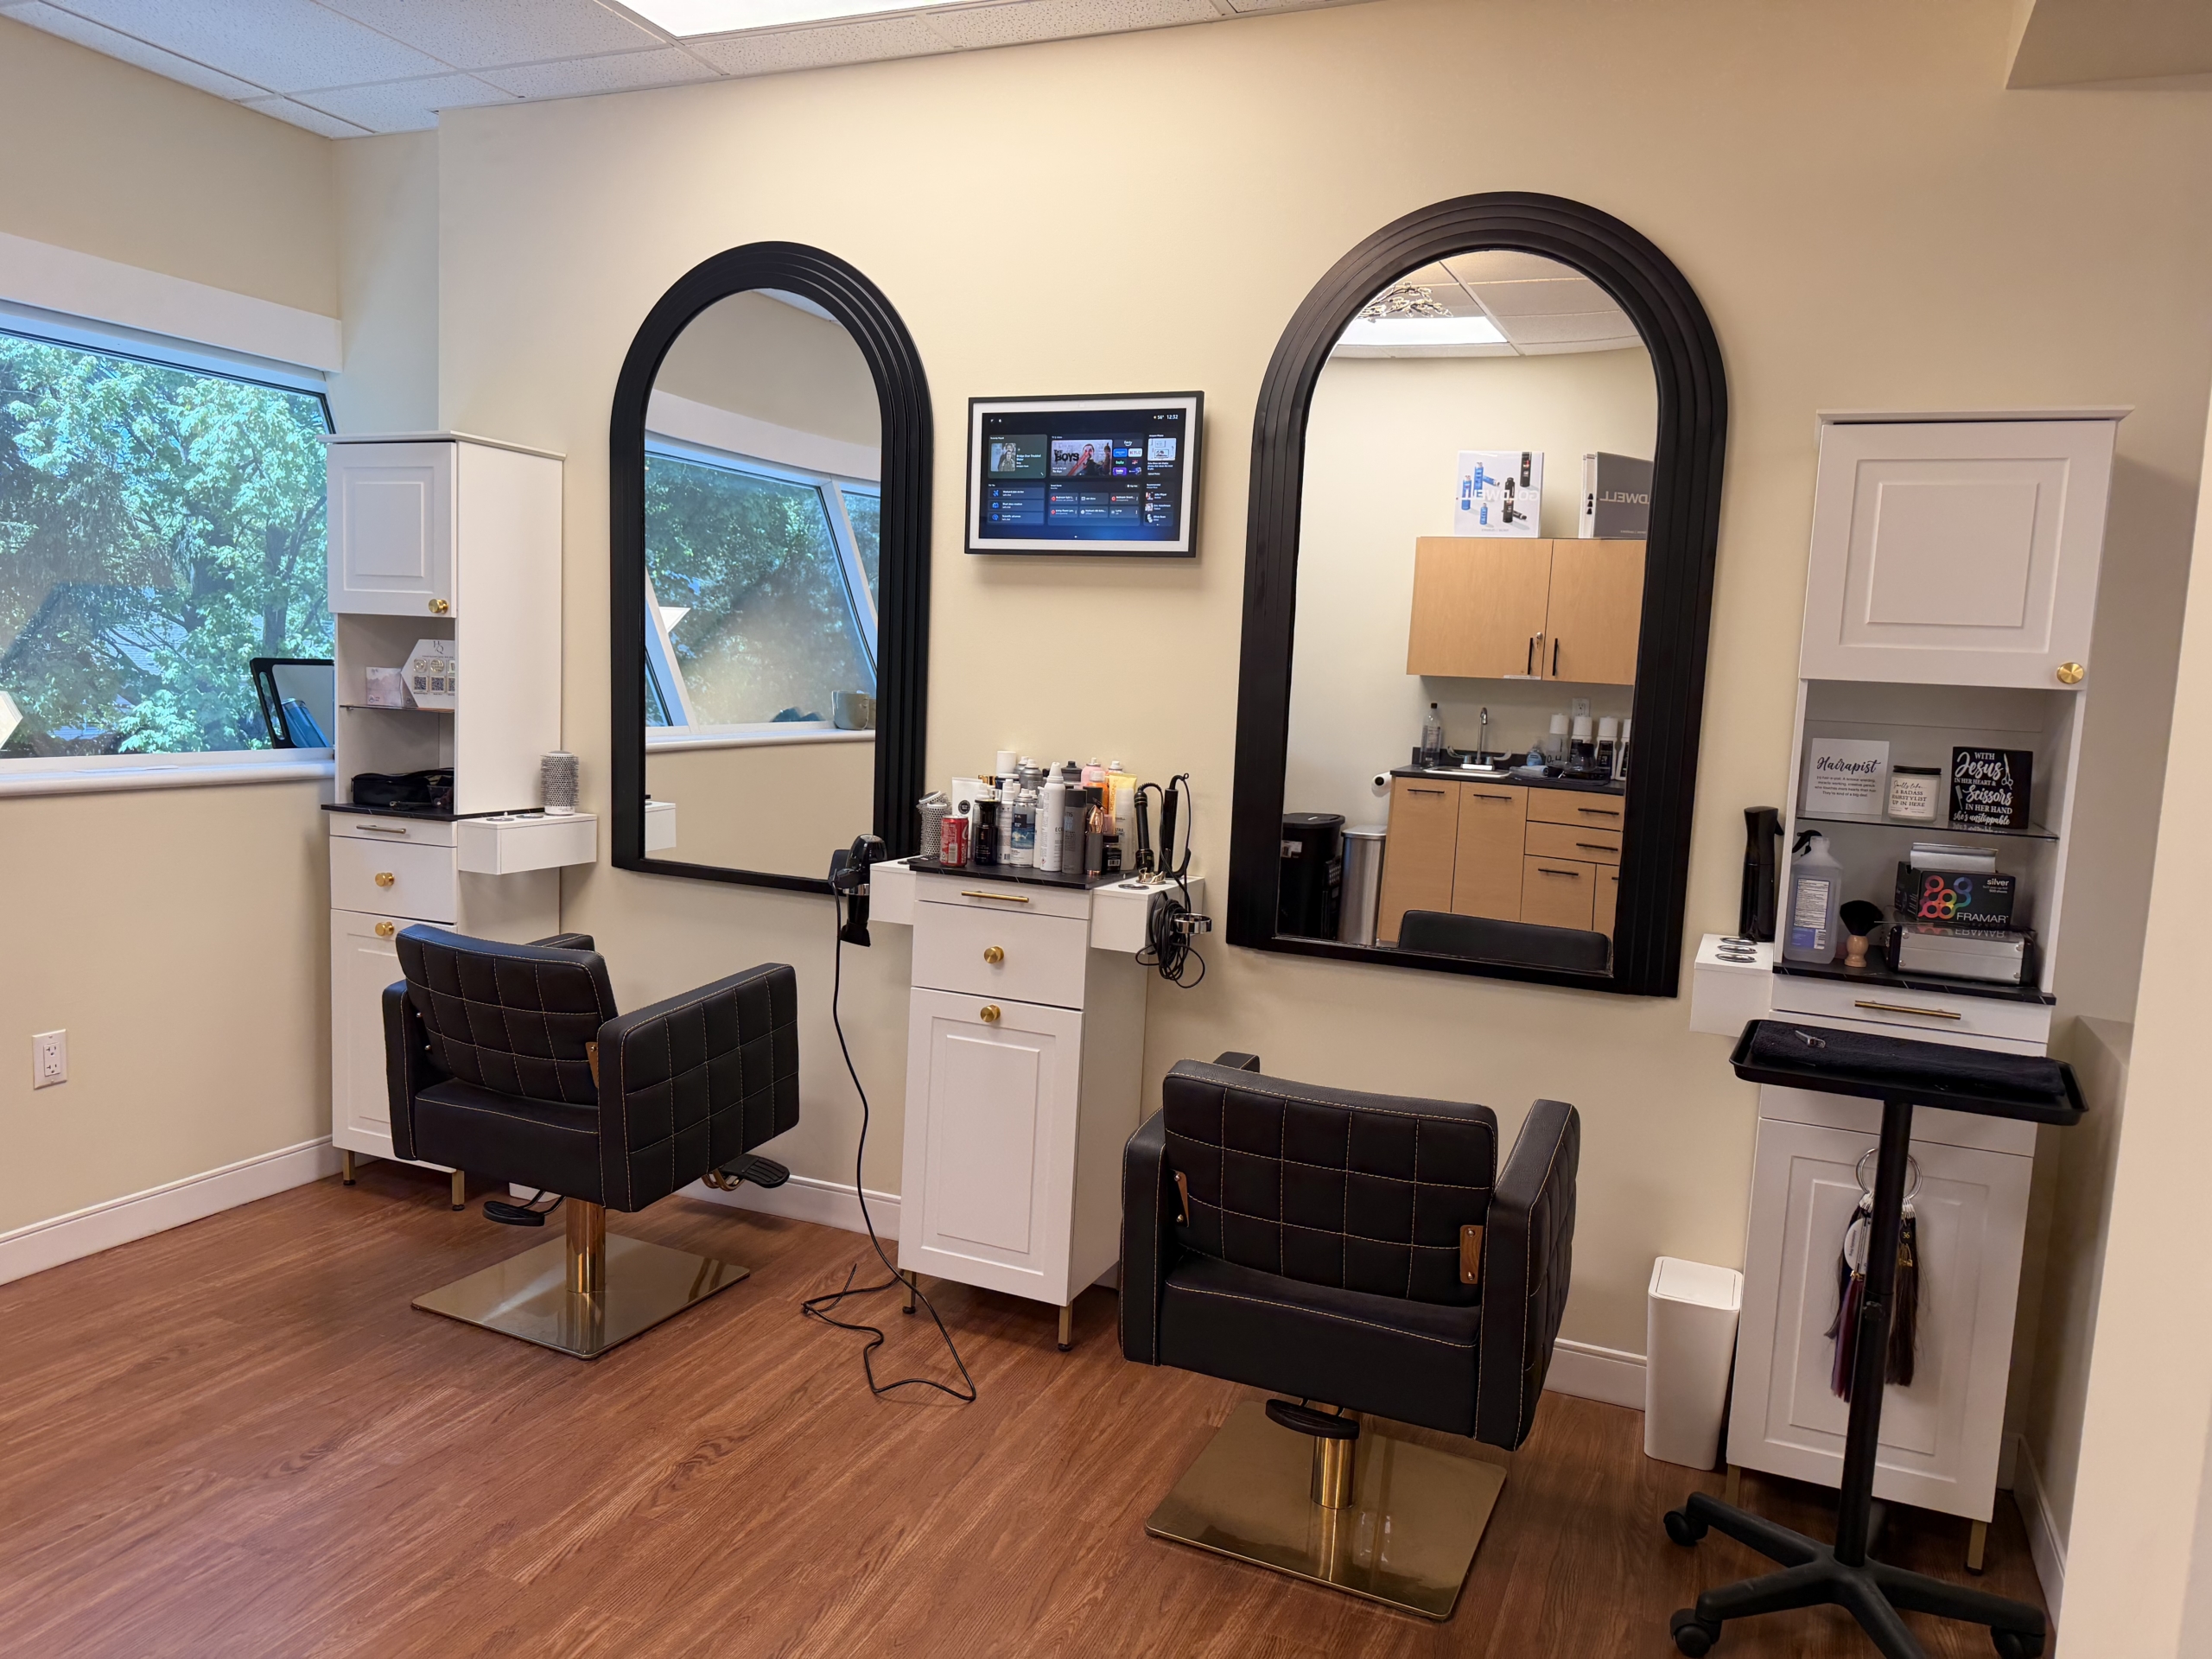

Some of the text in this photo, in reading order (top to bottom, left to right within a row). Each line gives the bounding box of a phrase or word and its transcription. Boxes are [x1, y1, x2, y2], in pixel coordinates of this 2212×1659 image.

[1055, 453, 1079, 463] BOYS
[1817, 756, 1881, 774] Hairapist
[1955, 751, 2004, 780] Jesus
[1962, 784, 2013, 806] Scissors
[1953, 810, 2010, 825] she's unstoppable
[1991, 806, 2013, 814] HAND
[1956, 912, 2007, 923] FRAMAR
